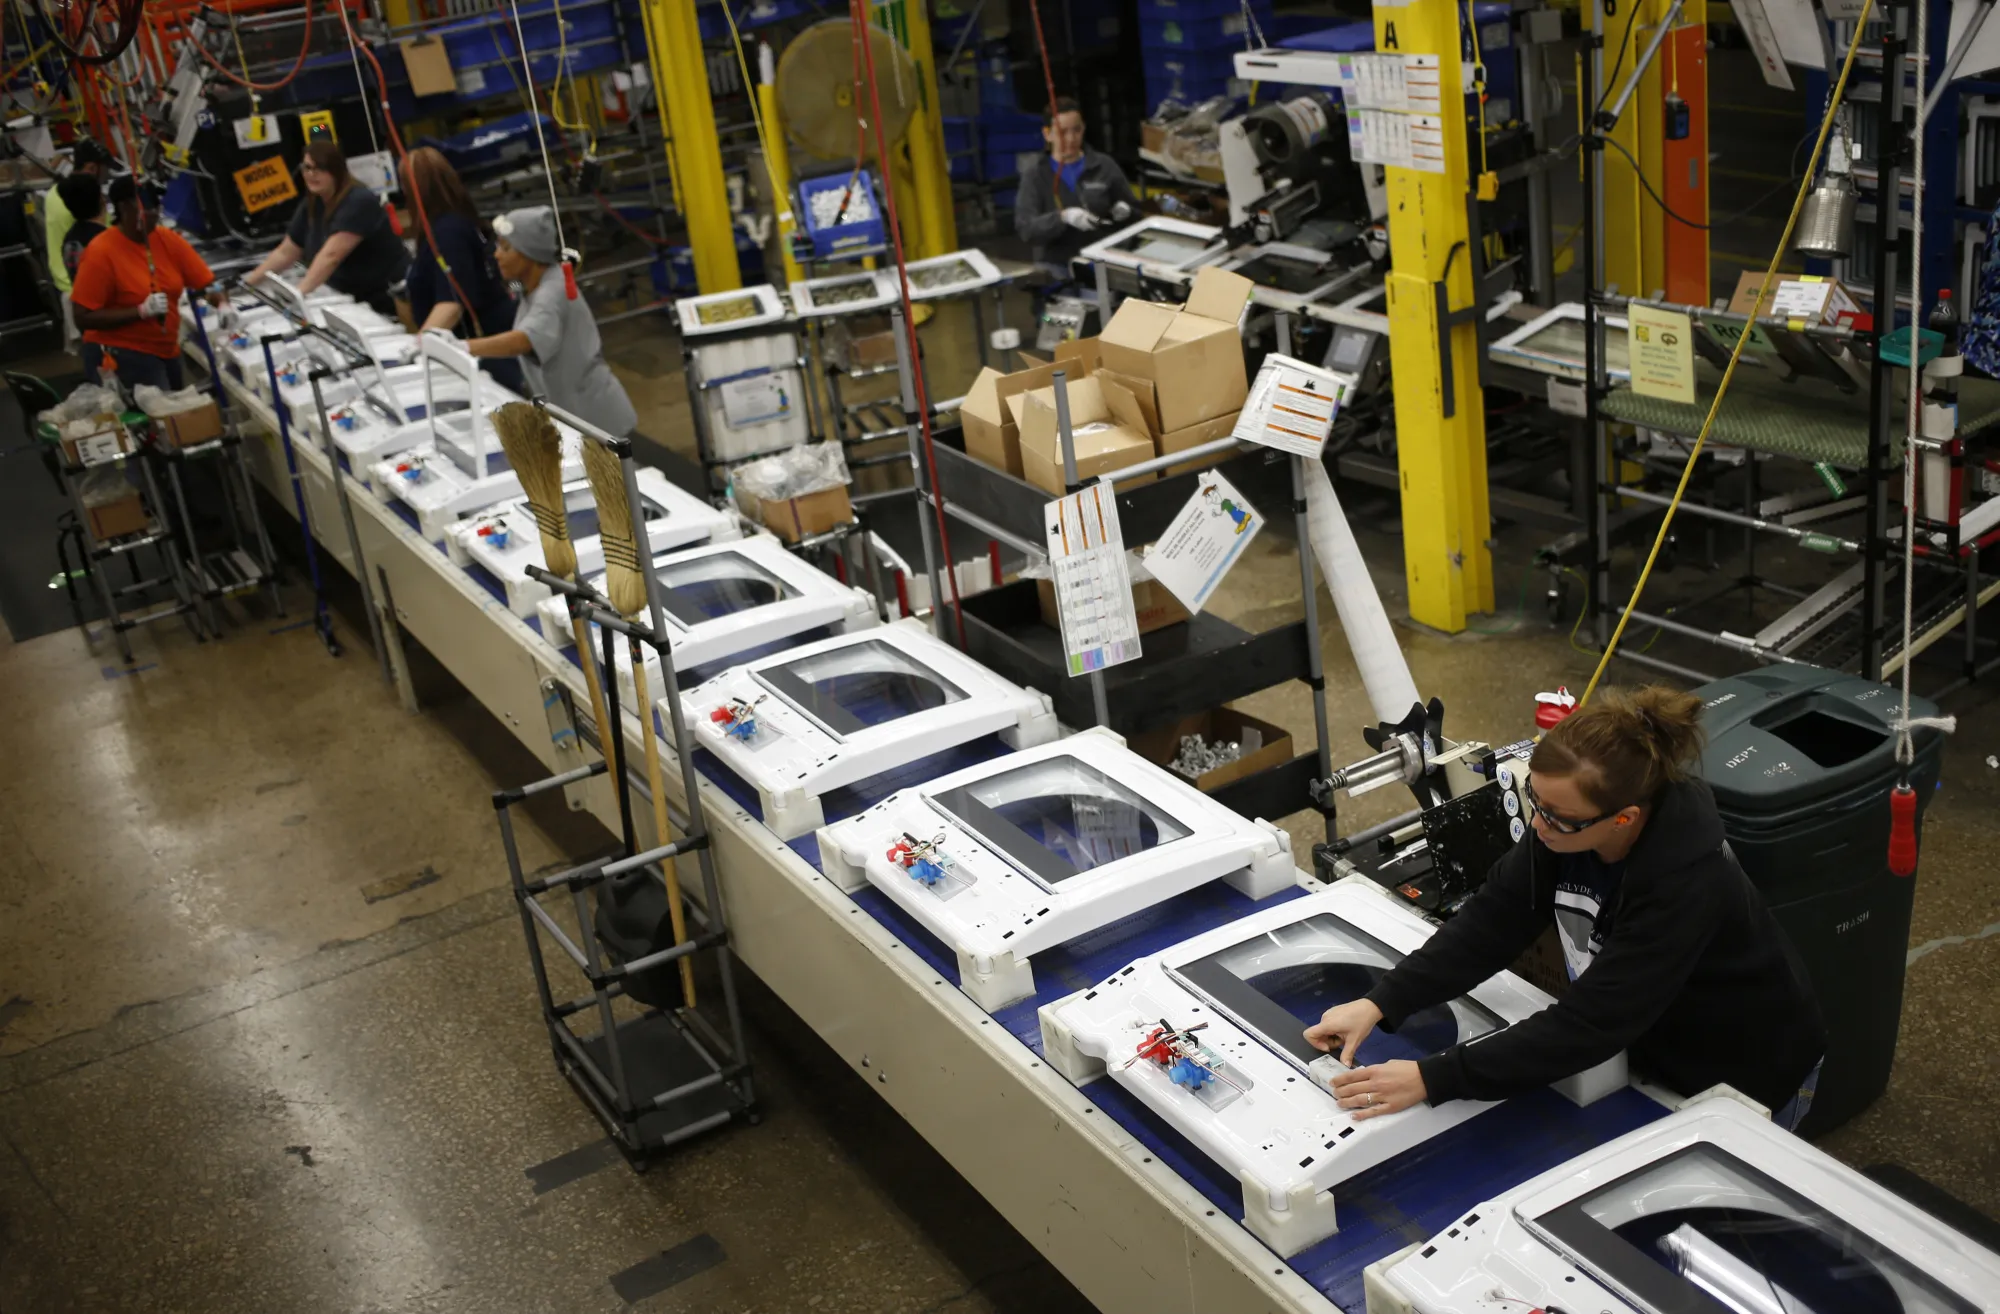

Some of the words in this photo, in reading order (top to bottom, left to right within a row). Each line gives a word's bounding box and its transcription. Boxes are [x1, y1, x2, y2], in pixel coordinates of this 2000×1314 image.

[1385, 21, 1399, 49] A
[243, 163, 279, 186] MODEL
[248, 181, 290, 207] CHANGE
[1725, 745, 1758, 769] DEPT
[1835, 910, 1870, 935] TRASH
